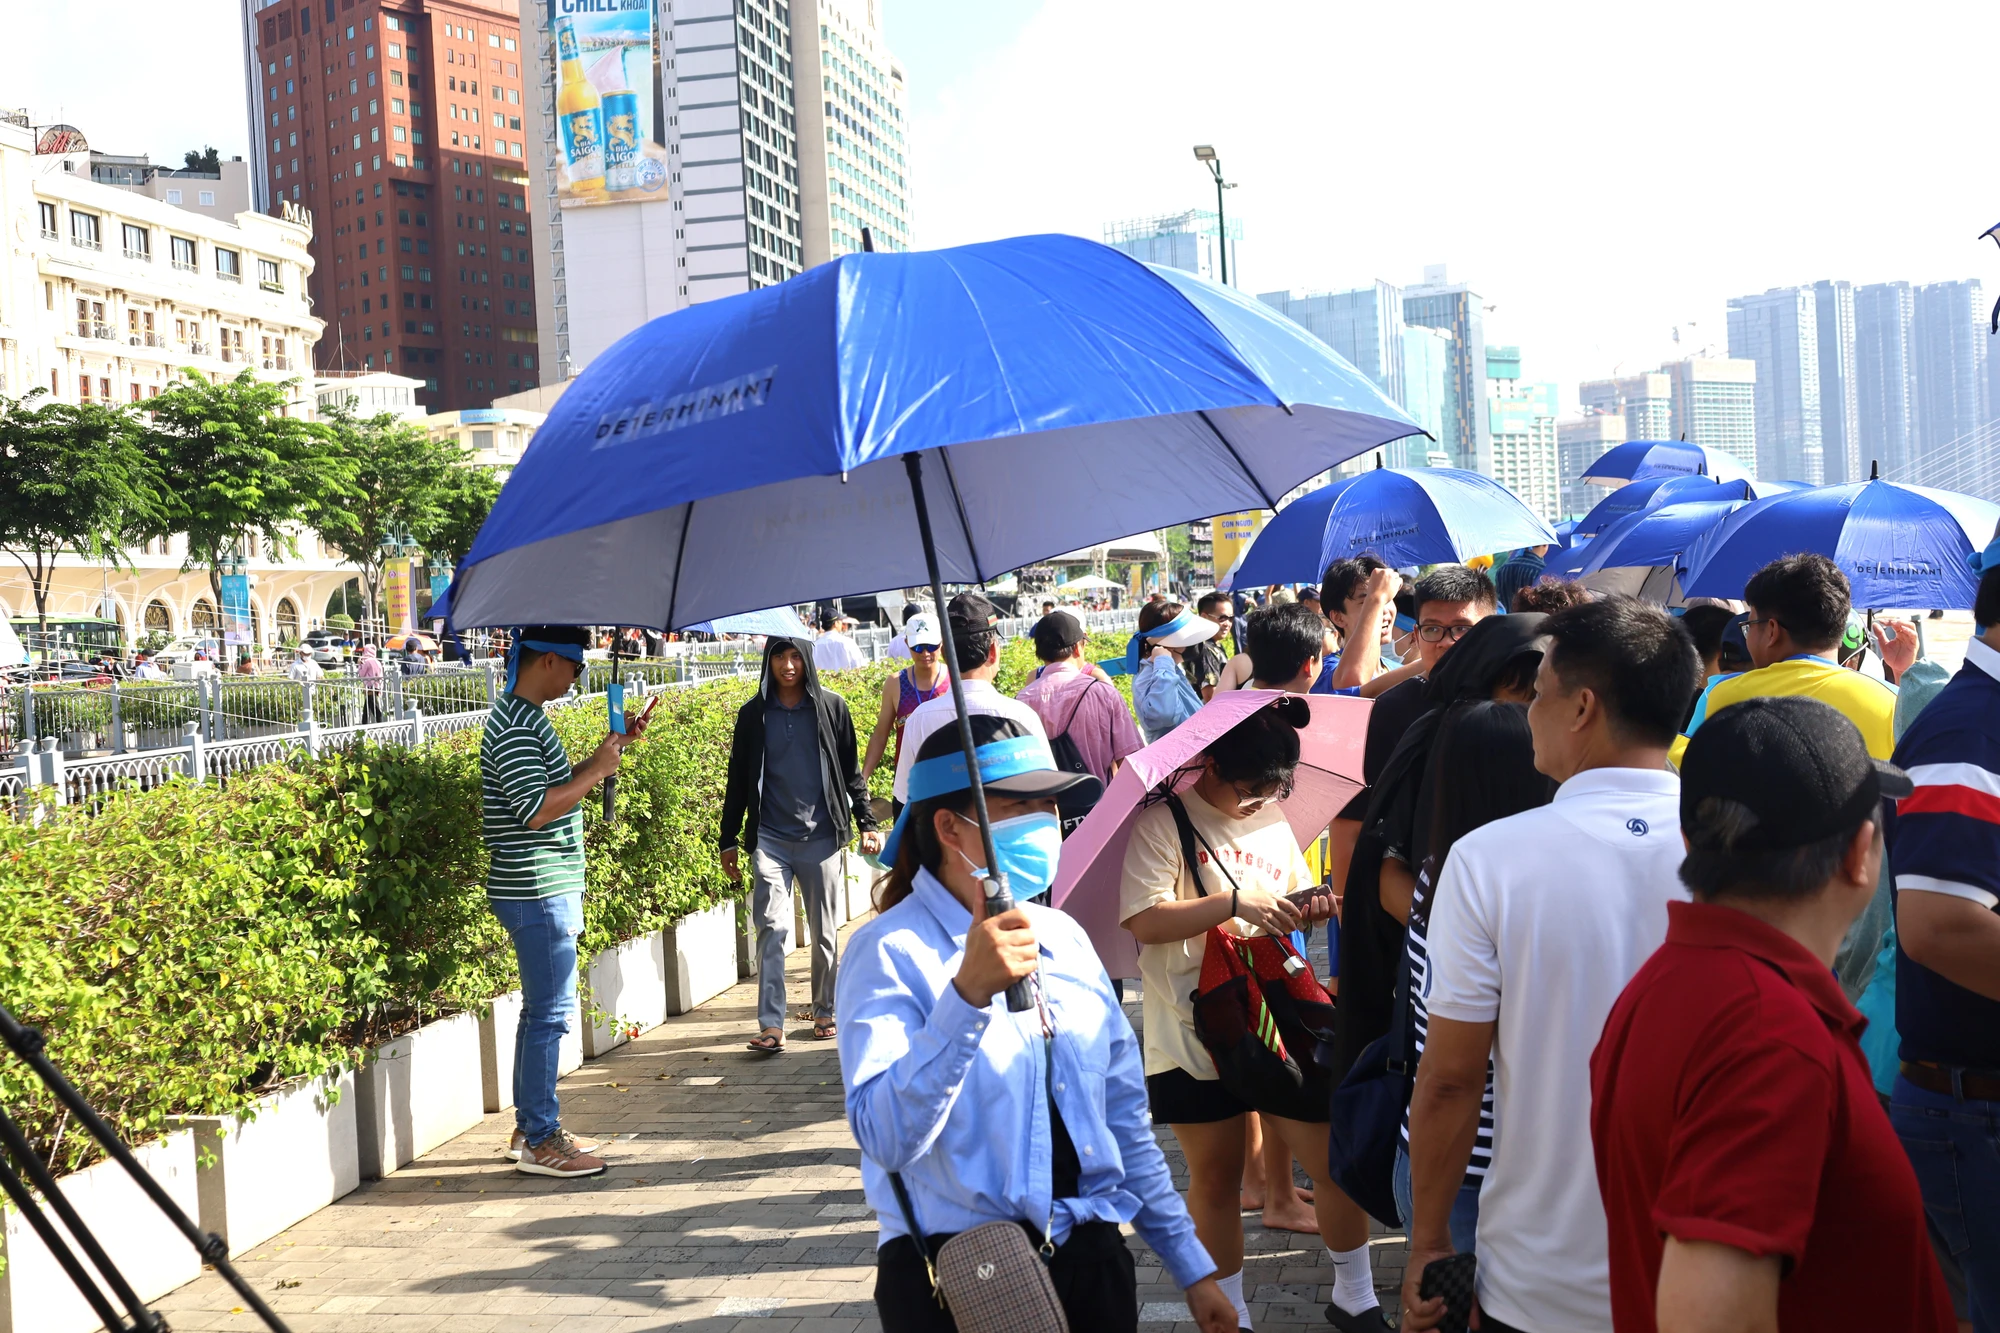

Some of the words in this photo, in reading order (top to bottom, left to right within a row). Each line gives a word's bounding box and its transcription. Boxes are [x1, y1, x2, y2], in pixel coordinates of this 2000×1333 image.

[595, 377, 773, 440] DETERMINANT
[1222, 520, 1234, 528] CON
[1350, 526, 1420, 545] DETERMINANT
[1857, 565, 1942, 576] DETERMINANT
